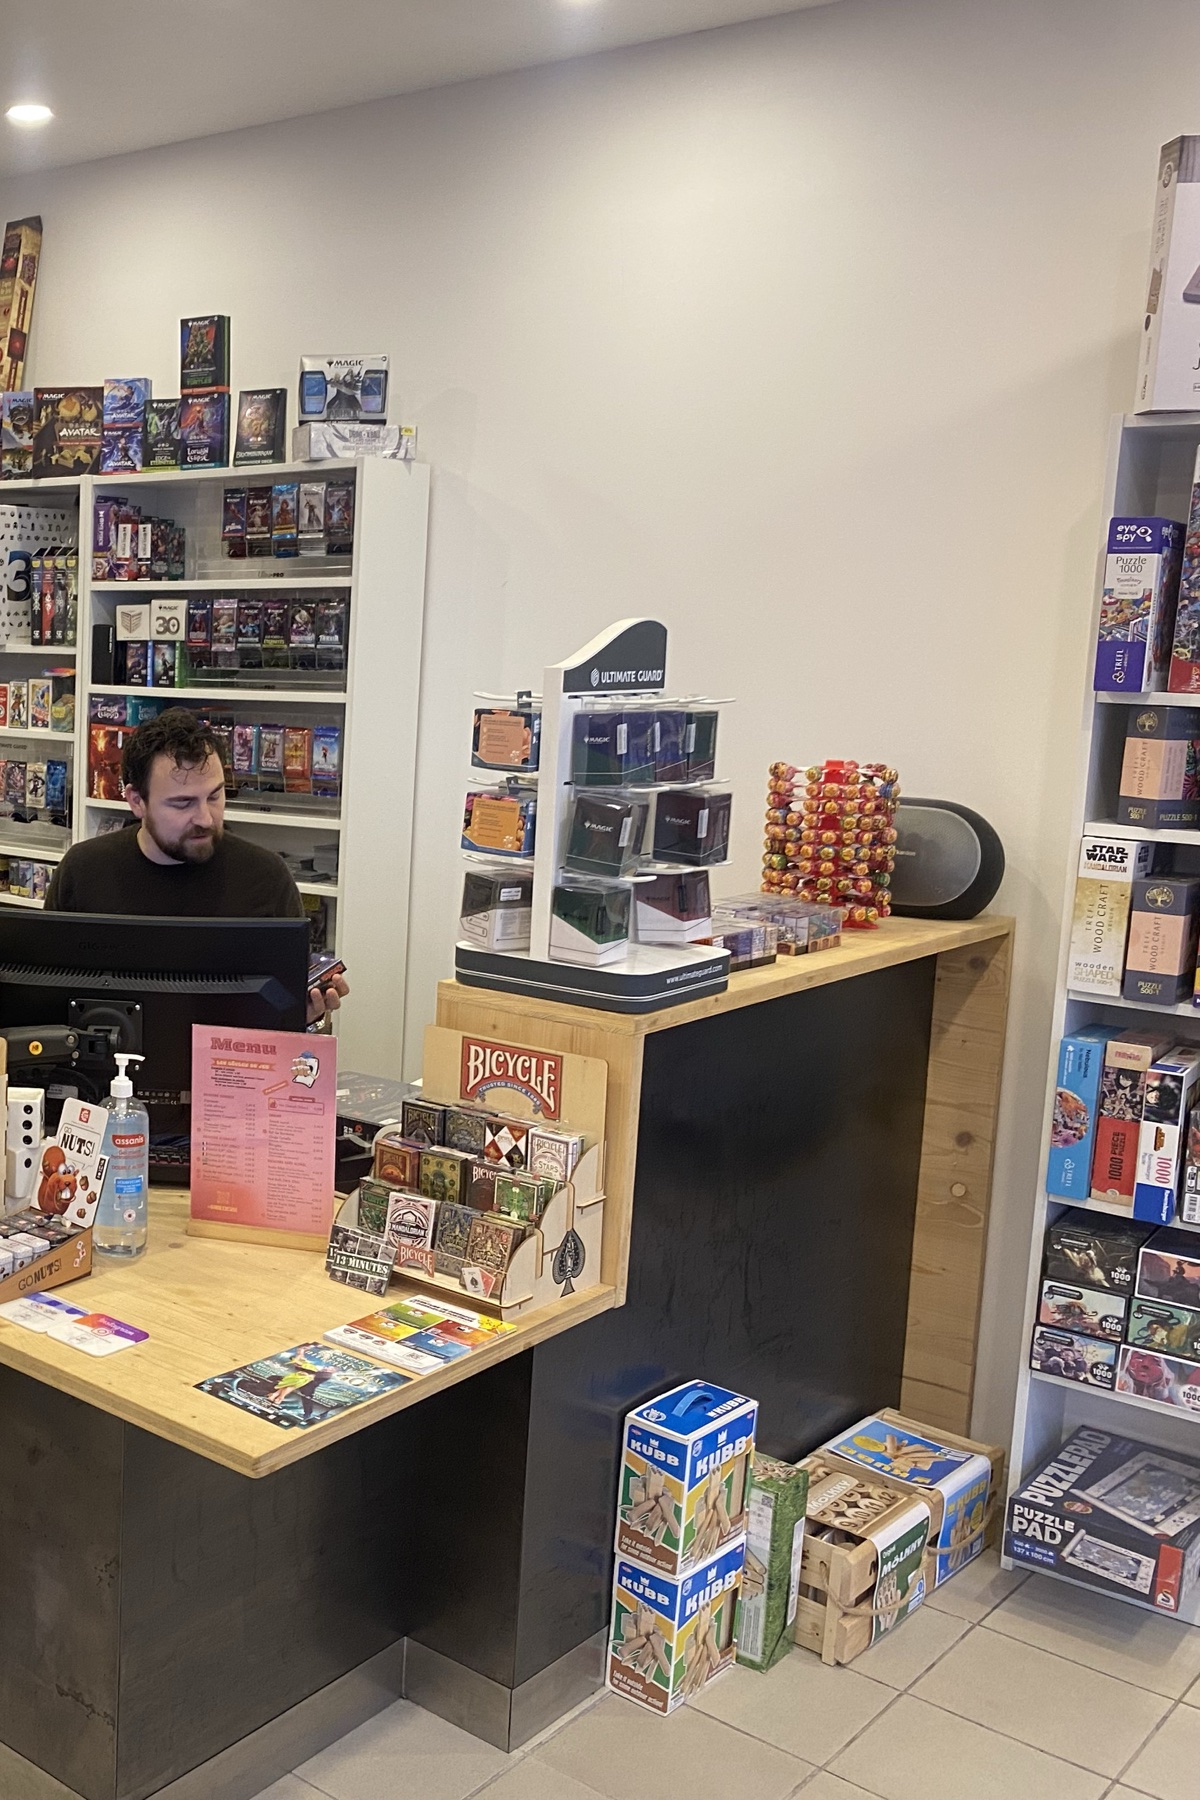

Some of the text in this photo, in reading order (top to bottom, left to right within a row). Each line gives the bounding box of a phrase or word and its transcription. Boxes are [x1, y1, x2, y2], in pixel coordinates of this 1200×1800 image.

[334, 359, 364, 367] MAGIC
[59, 427, 101, 437] AVATAR
[1116, 533, 1137, 543] spy
[1117, 525, 1137, 534] eye
[1116, 556, 1147, 565] Puzzle
[1119, 564, 1143, 573] 1000
[155, 616, 180, 635] 30
[601, 669, 663, 683] ULTIMATE GUARD
[1137, 741, 1148, 796] WOOD CRAFT
[591, 823, 613, 833] MAGIC
[670, 817, 691, 825] MAGIC
[1085, 844, 1129, 856] STAR
[1086, 853, 1128, 864] WARS
[1085, 903, 1095, 931] TREFL
[1093, 884, 1109, 954] WOOD CRAFT
[1149, 916, 1162, 971] WOOD CRAFT
[666, 964, 723, 984] www.ultimateguard.com
[1074, 968, 1114, 981] SHAPED
[1075, 962, 1114, 972] wooden
[210, 1036, 277, 1056] Menu
[466, 1045, 555, 1112] BICYCLE
[479, 1081, 526, 1094] TRUSTED SINCE
[60, 1133, 95, 1158] NUTS!
[114, 1135, 144, 1145] assanis
[536, 1139, 565, 1154] BICYCLE
[1112, 1131, 1121, 1157] PIECE
[472, 1166, 496, 1183] BICYC
[538, 1160, 559, 1173] STARS
[1108, 1157, 1124, 1181] 1000
[1155, 1157, 1173, 1184] 1000
[391, 1223, 426, 1236] MANDALORIAN
[335, 1253, 389, 1275] 13 MINUTES
[399, 1248, 434, 1274] BICYCLE
[1110, 1271, 1131, 1282] 1000
[1102, 1320, 1122, 1332] 1000
[1092, 1367, 1113, 1379] 1000
[717, 1397, 748, 1415] KUBB
[630, 1439, 680, 1467] KUBB
[695, 1436, 748, 1479] KUBB
[1013, 1504, 1075, 1533] PUZZLE
[1012, 1515, 1062, 1546] PAD
[881, 1535, 924, 1578] MÖLKKY
[621, 1576, 671, 1606] KUBB
[685, 1570, 737, 1617] KUBB
